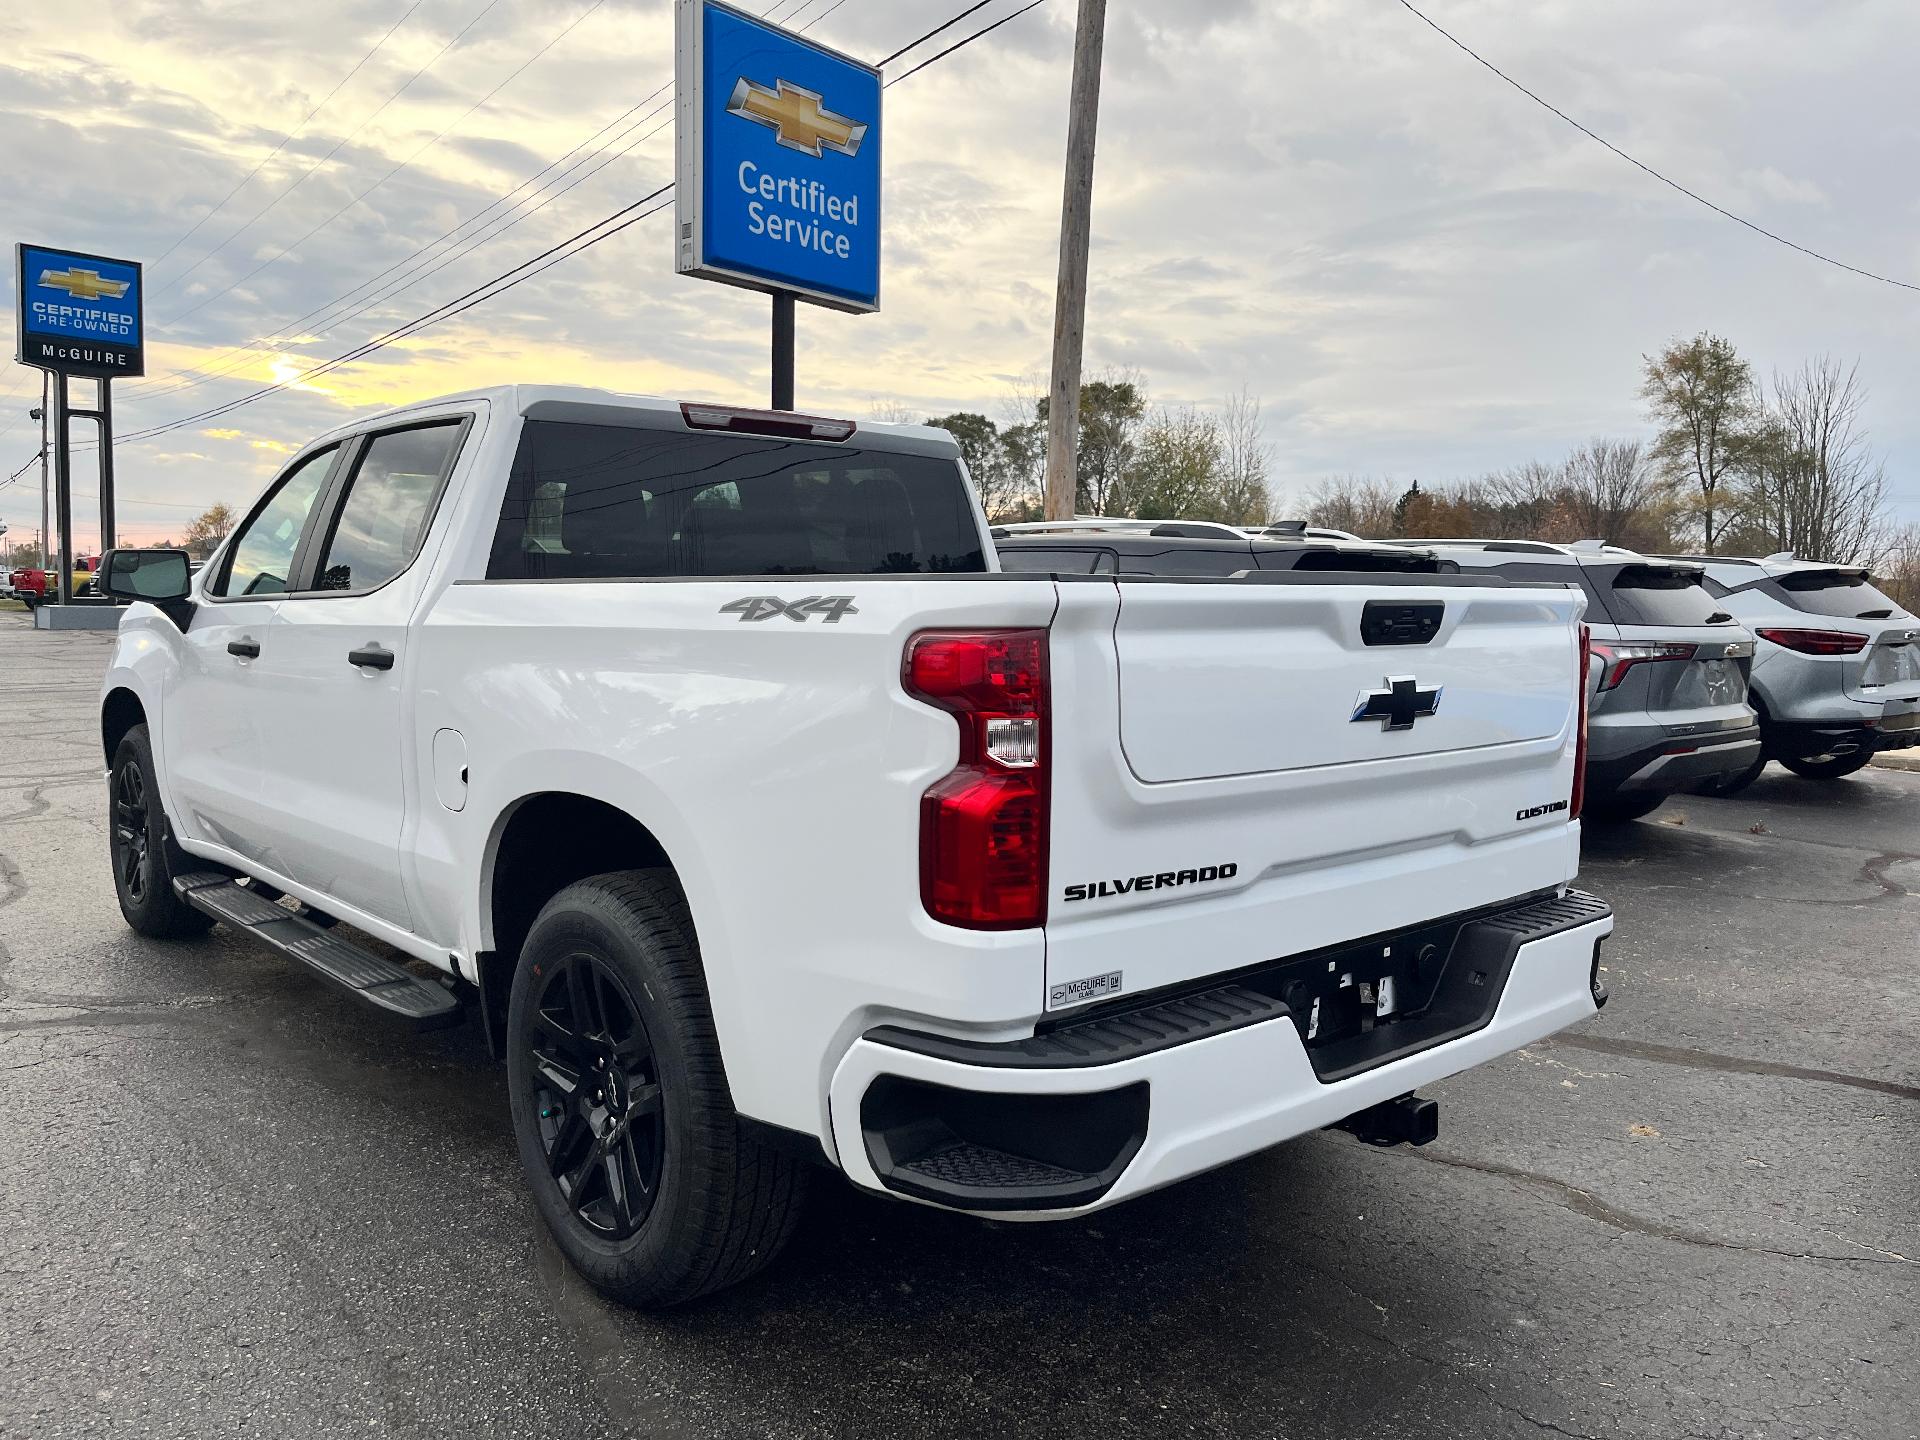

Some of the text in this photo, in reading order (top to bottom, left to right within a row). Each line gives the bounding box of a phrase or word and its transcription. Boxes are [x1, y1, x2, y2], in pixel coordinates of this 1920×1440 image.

[738, 160, 858, 226] Certified
[748, 201, 850, 259] Service
[32, 301, 134, 326] CERTIFIED
[38, 314, 129, 335] PRE-OWNED
[42, 344, 127, 365] McGUIRE
[1063, 862, 1238, 902] SILVERADO
[1068, 976, 1106, 995] McGUIRE
